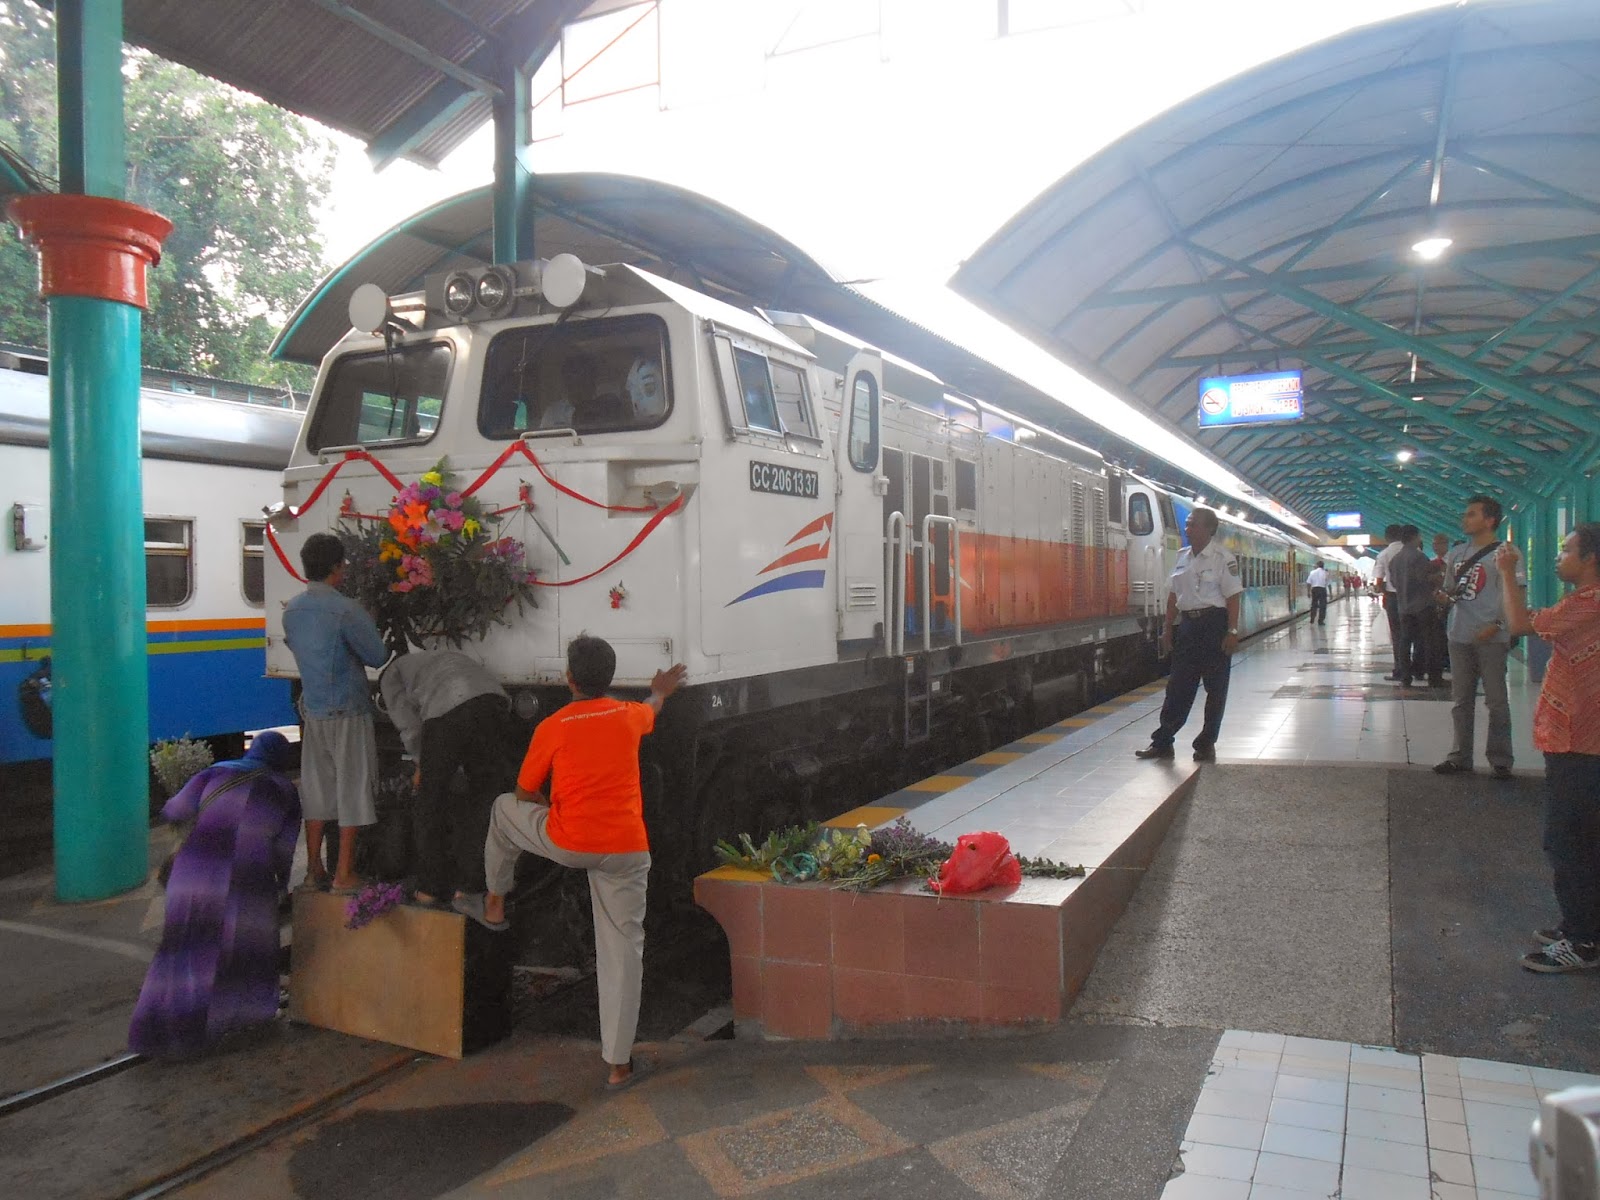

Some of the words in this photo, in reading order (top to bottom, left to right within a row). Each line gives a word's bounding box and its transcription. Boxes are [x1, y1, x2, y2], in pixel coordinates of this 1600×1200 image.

[752, 464, 770, 488] CC
[771, 467, 792, 492] 206
[792, 471, 804, 495] 13
[805, 472, 817, 495] 37
[711, 695, 723, 707] 2A
